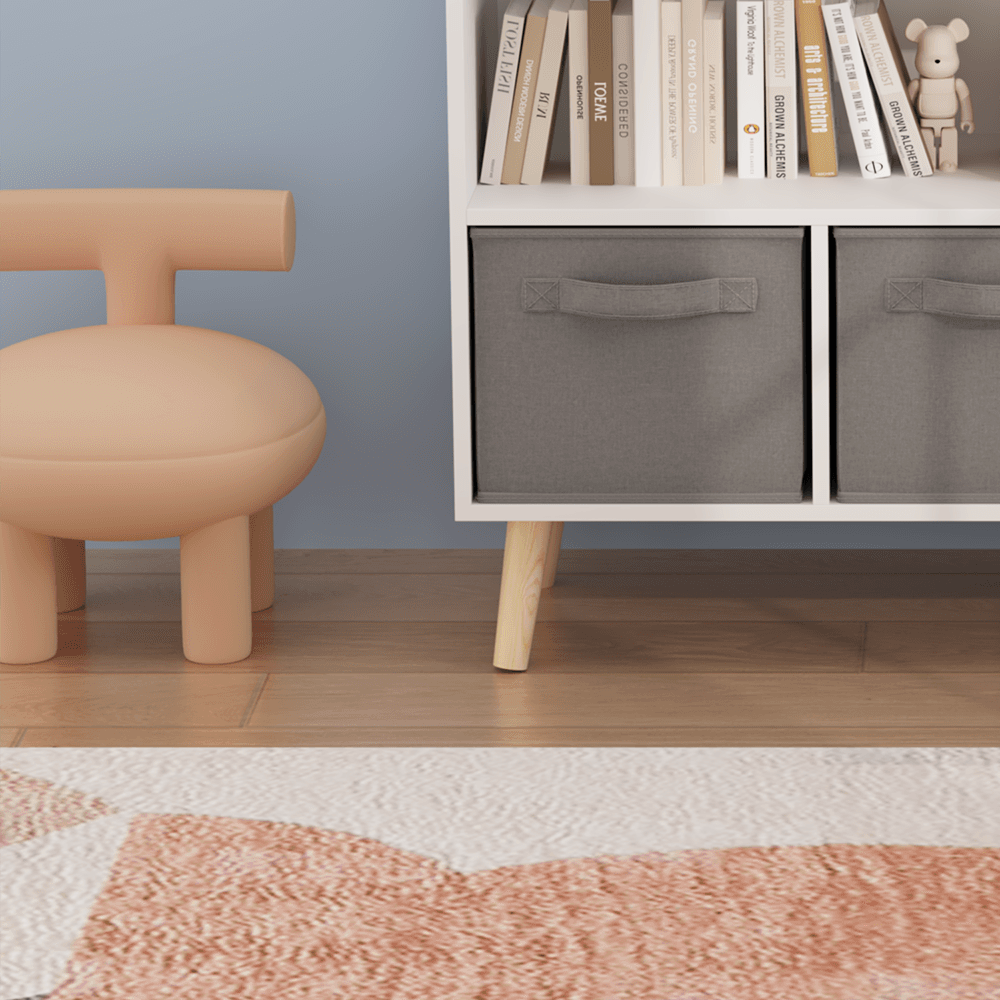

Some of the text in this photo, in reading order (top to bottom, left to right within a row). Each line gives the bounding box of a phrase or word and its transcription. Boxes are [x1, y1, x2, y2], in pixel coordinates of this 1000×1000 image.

[773, 0, 786, 79] ROWN ALCHEMIST
[804, 45, 823, 64] arts
[860, 15, 878, 41] ROWN
[869, 43, 894, 86] ALCHEMIST
[774, 95, 786, 180] GROWN ALCHEMIS
[807, 77, 828, 133] architecture
[889, 100, 924, 178] GROWN ALCHEMIS
